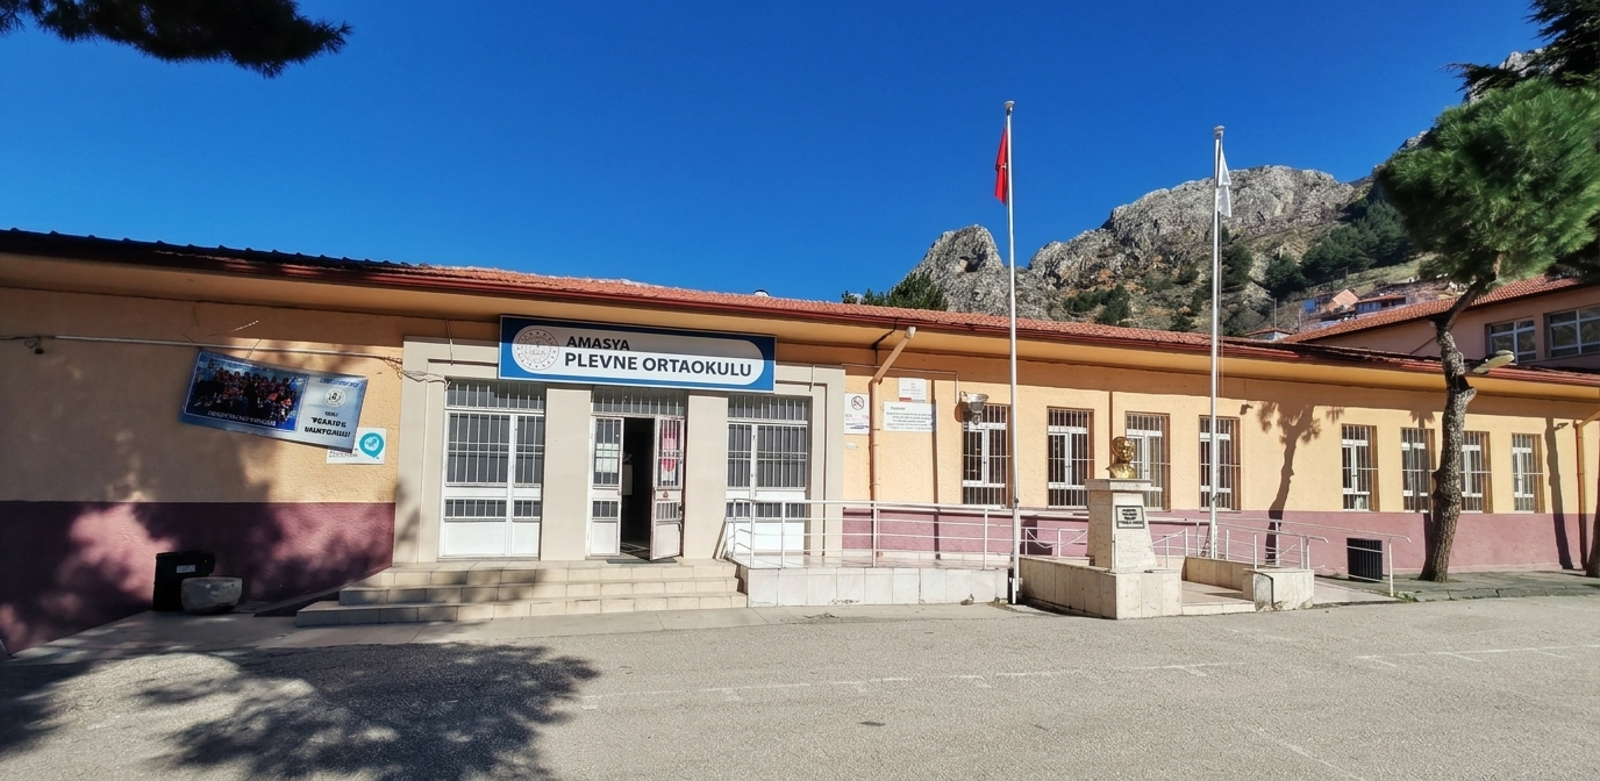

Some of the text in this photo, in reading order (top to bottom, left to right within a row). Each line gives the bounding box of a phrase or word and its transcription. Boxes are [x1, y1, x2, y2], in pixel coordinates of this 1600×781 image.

[566, 336, 630, 351] AMASYA
[564, 352, 752, 377] PLEVNE ORTAOKULU
